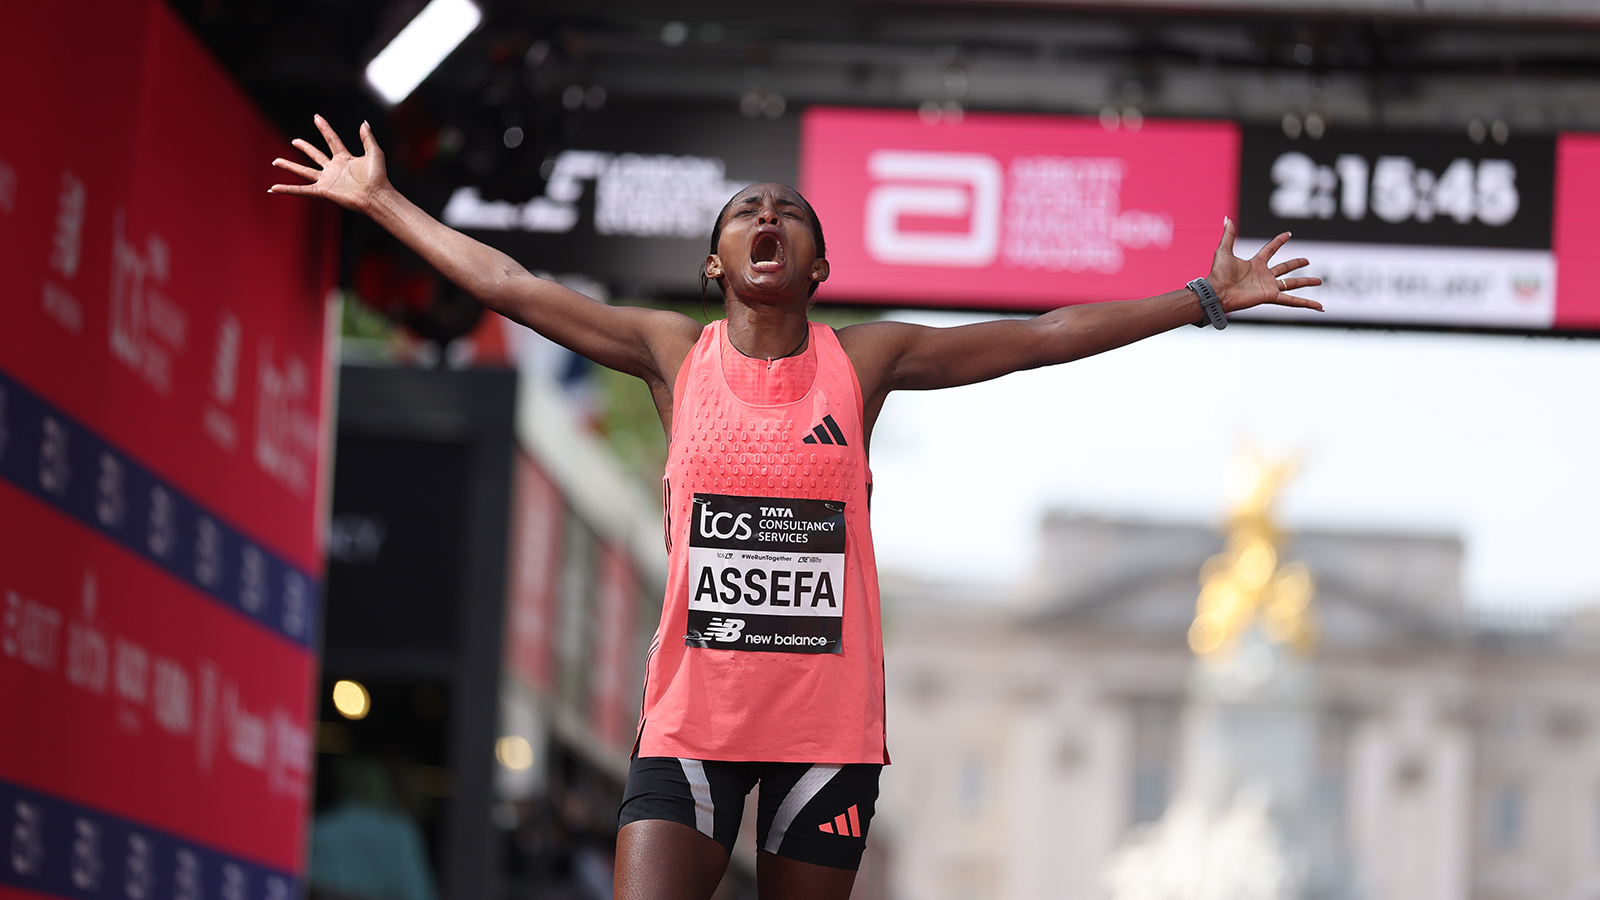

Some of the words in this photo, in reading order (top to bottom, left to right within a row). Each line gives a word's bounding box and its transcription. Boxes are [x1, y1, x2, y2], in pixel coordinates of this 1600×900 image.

[1269, 150, 1520, 227] 2:15:45
[760, 506, 794, 518] TATA
[699, 503, 752, 540] tcs
[758, 519, 836, 532] CONSULTANCY
[758, 532, 808, 543] SERVICES
[741, 554, 792, 562] #WeRunTogether
[694, 566, 837, 608] ASSEFA
[745, 634, 772, 645] new
[774, 633, 827, 646] balance
